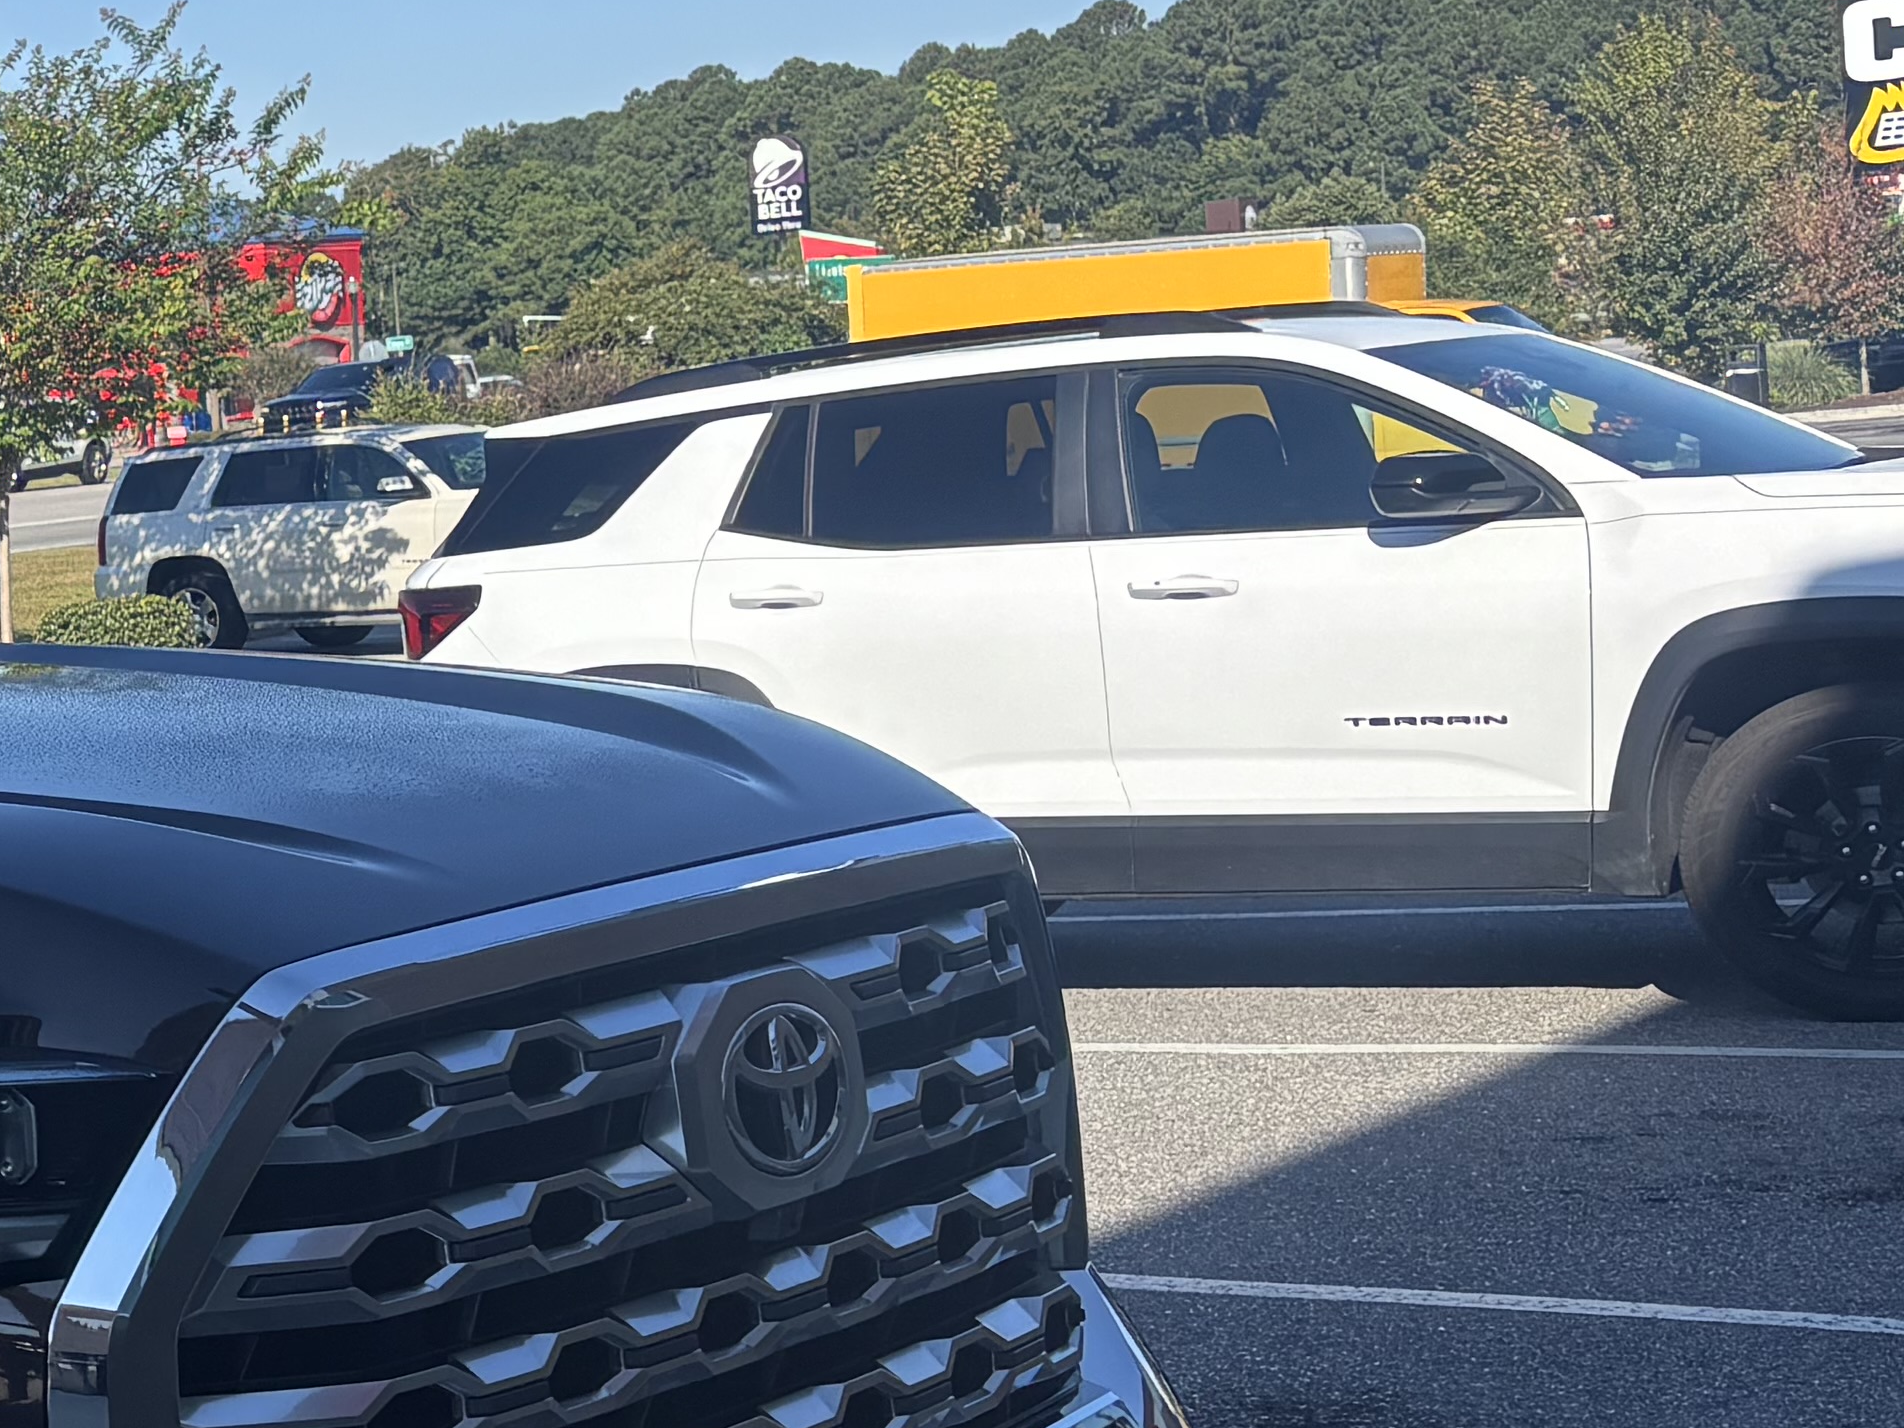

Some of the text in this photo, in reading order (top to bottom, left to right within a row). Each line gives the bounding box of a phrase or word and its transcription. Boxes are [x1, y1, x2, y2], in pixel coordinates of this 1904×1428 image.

[752, 184, 802, 204] TACO
[758, 201, 803, 220] BELL
[1343, 715, 1508, 727] TERRAIN
